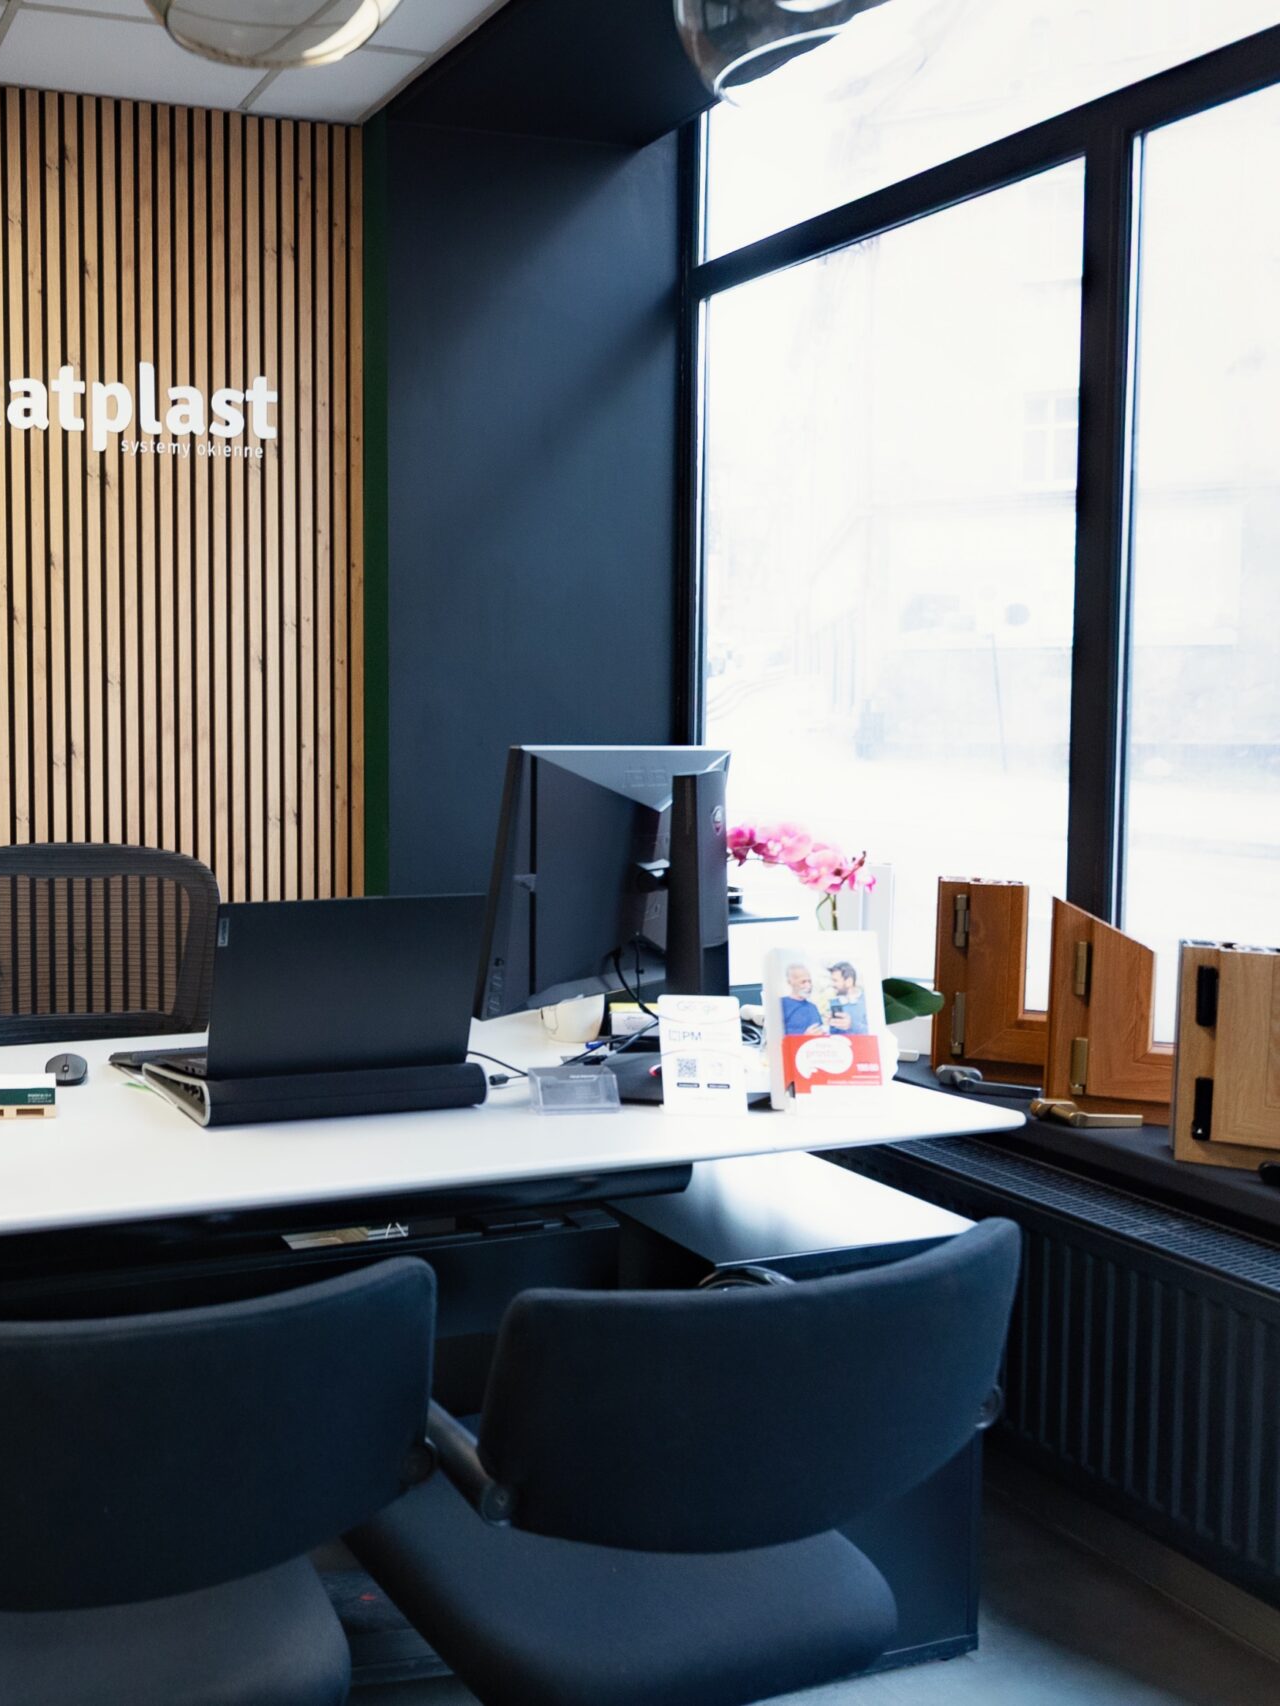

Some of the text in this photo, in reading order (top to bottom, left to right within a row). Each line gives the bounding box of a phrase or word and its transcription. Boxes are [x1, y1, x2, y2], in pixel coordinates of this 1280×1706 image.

[120, 439, 264, 460] systemy okienne
[676, 1000, 718, 1016] Goge
[682, 1031, 703, 1041] PM
